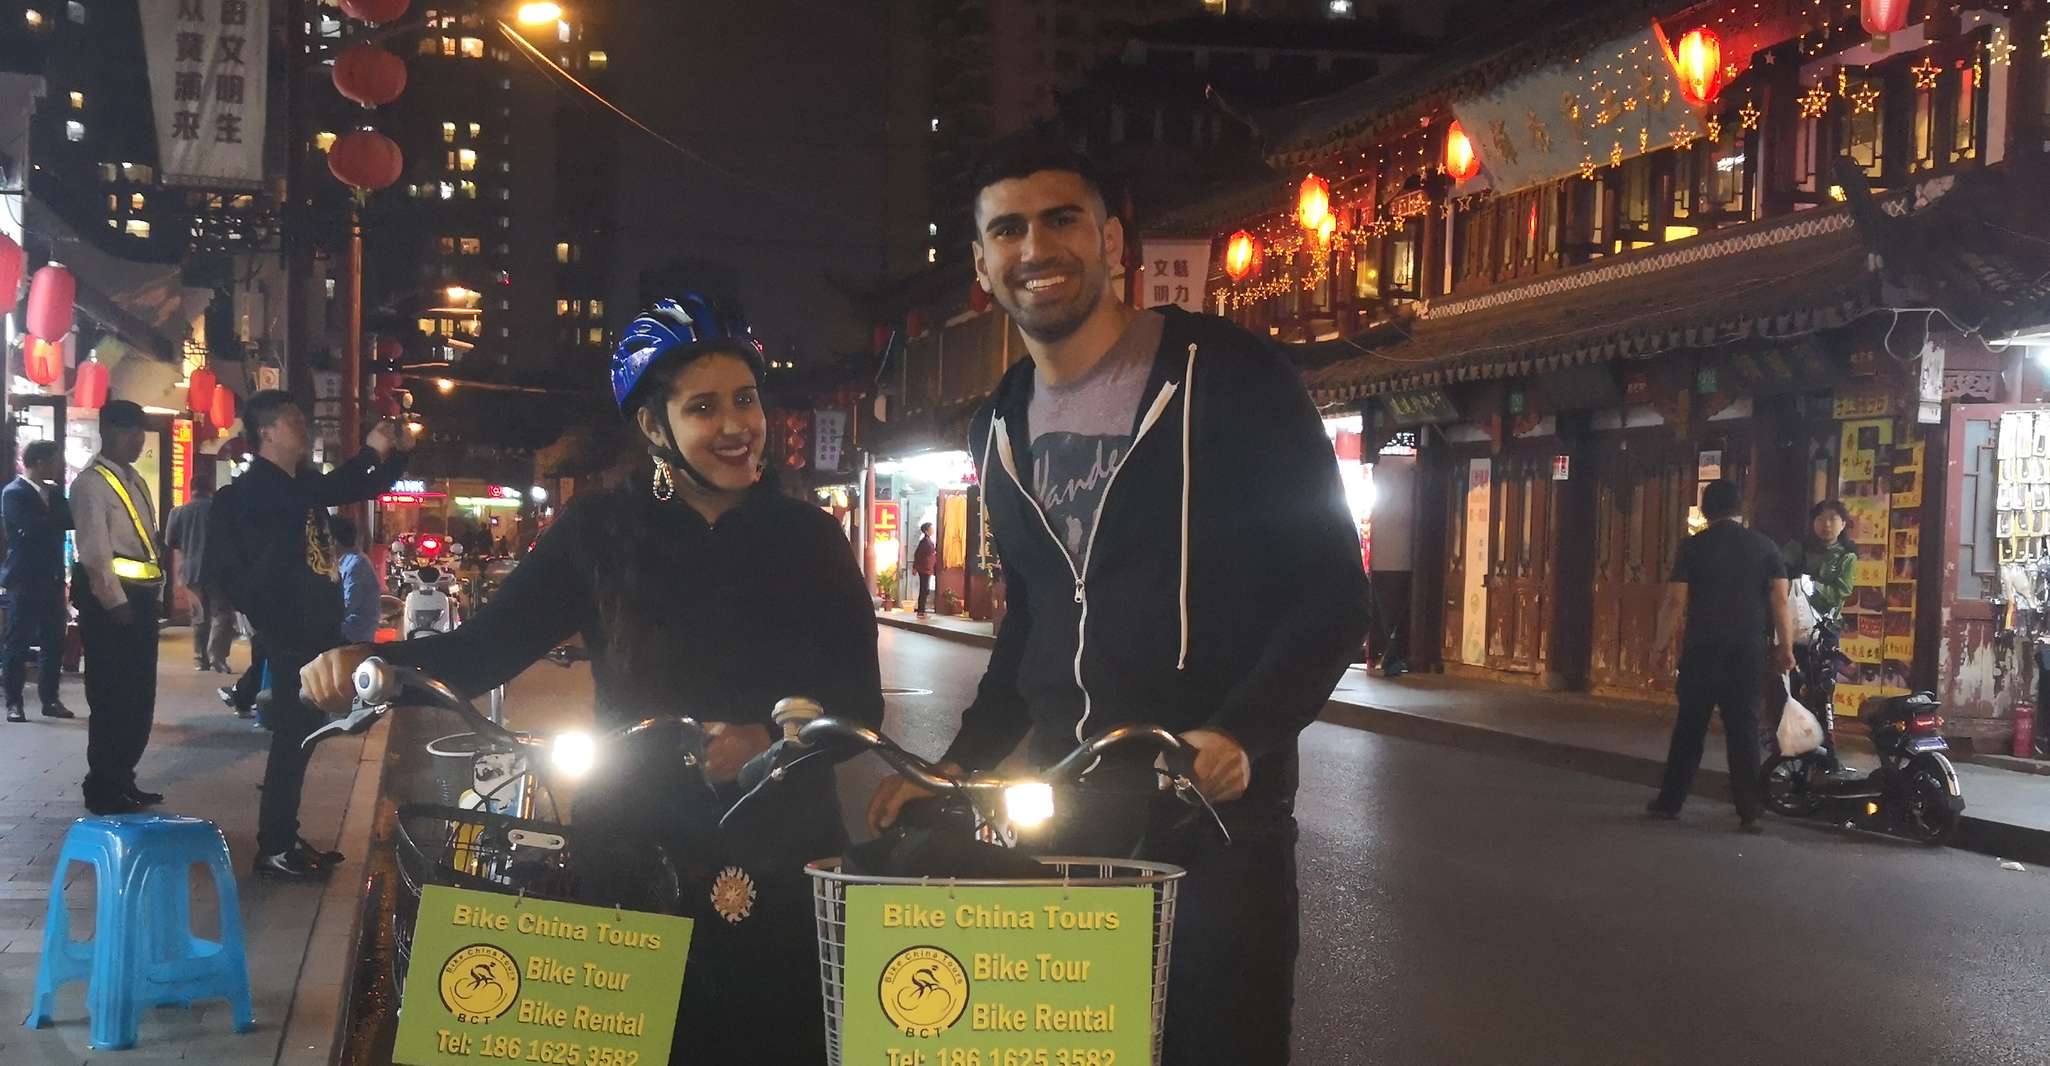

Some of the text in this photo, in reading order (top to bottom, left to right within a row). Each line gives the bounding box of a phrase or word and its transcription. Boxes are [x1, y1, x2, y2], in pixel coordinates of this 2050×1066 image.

[452, 904, 663, 950] Bike China Tours
[883, 903, 1120, 930] Bike China Tours
[526, 956, 631, 992] Bike Tour
[885, 961, 902, 983] Bike
[905, 951, 938, 961] China
[974, 953, 1091, 983] Bike Tour
[457, 1013, 491, 1025] BCT
[518, 999, 646, 1036] Bike Rental
[905, 1027, 942, 1039] BCT
[972, 1003, 1115, 1032] Bike Rental
[437, 1029, 640, 1066] Tel: 186 1625 3582
